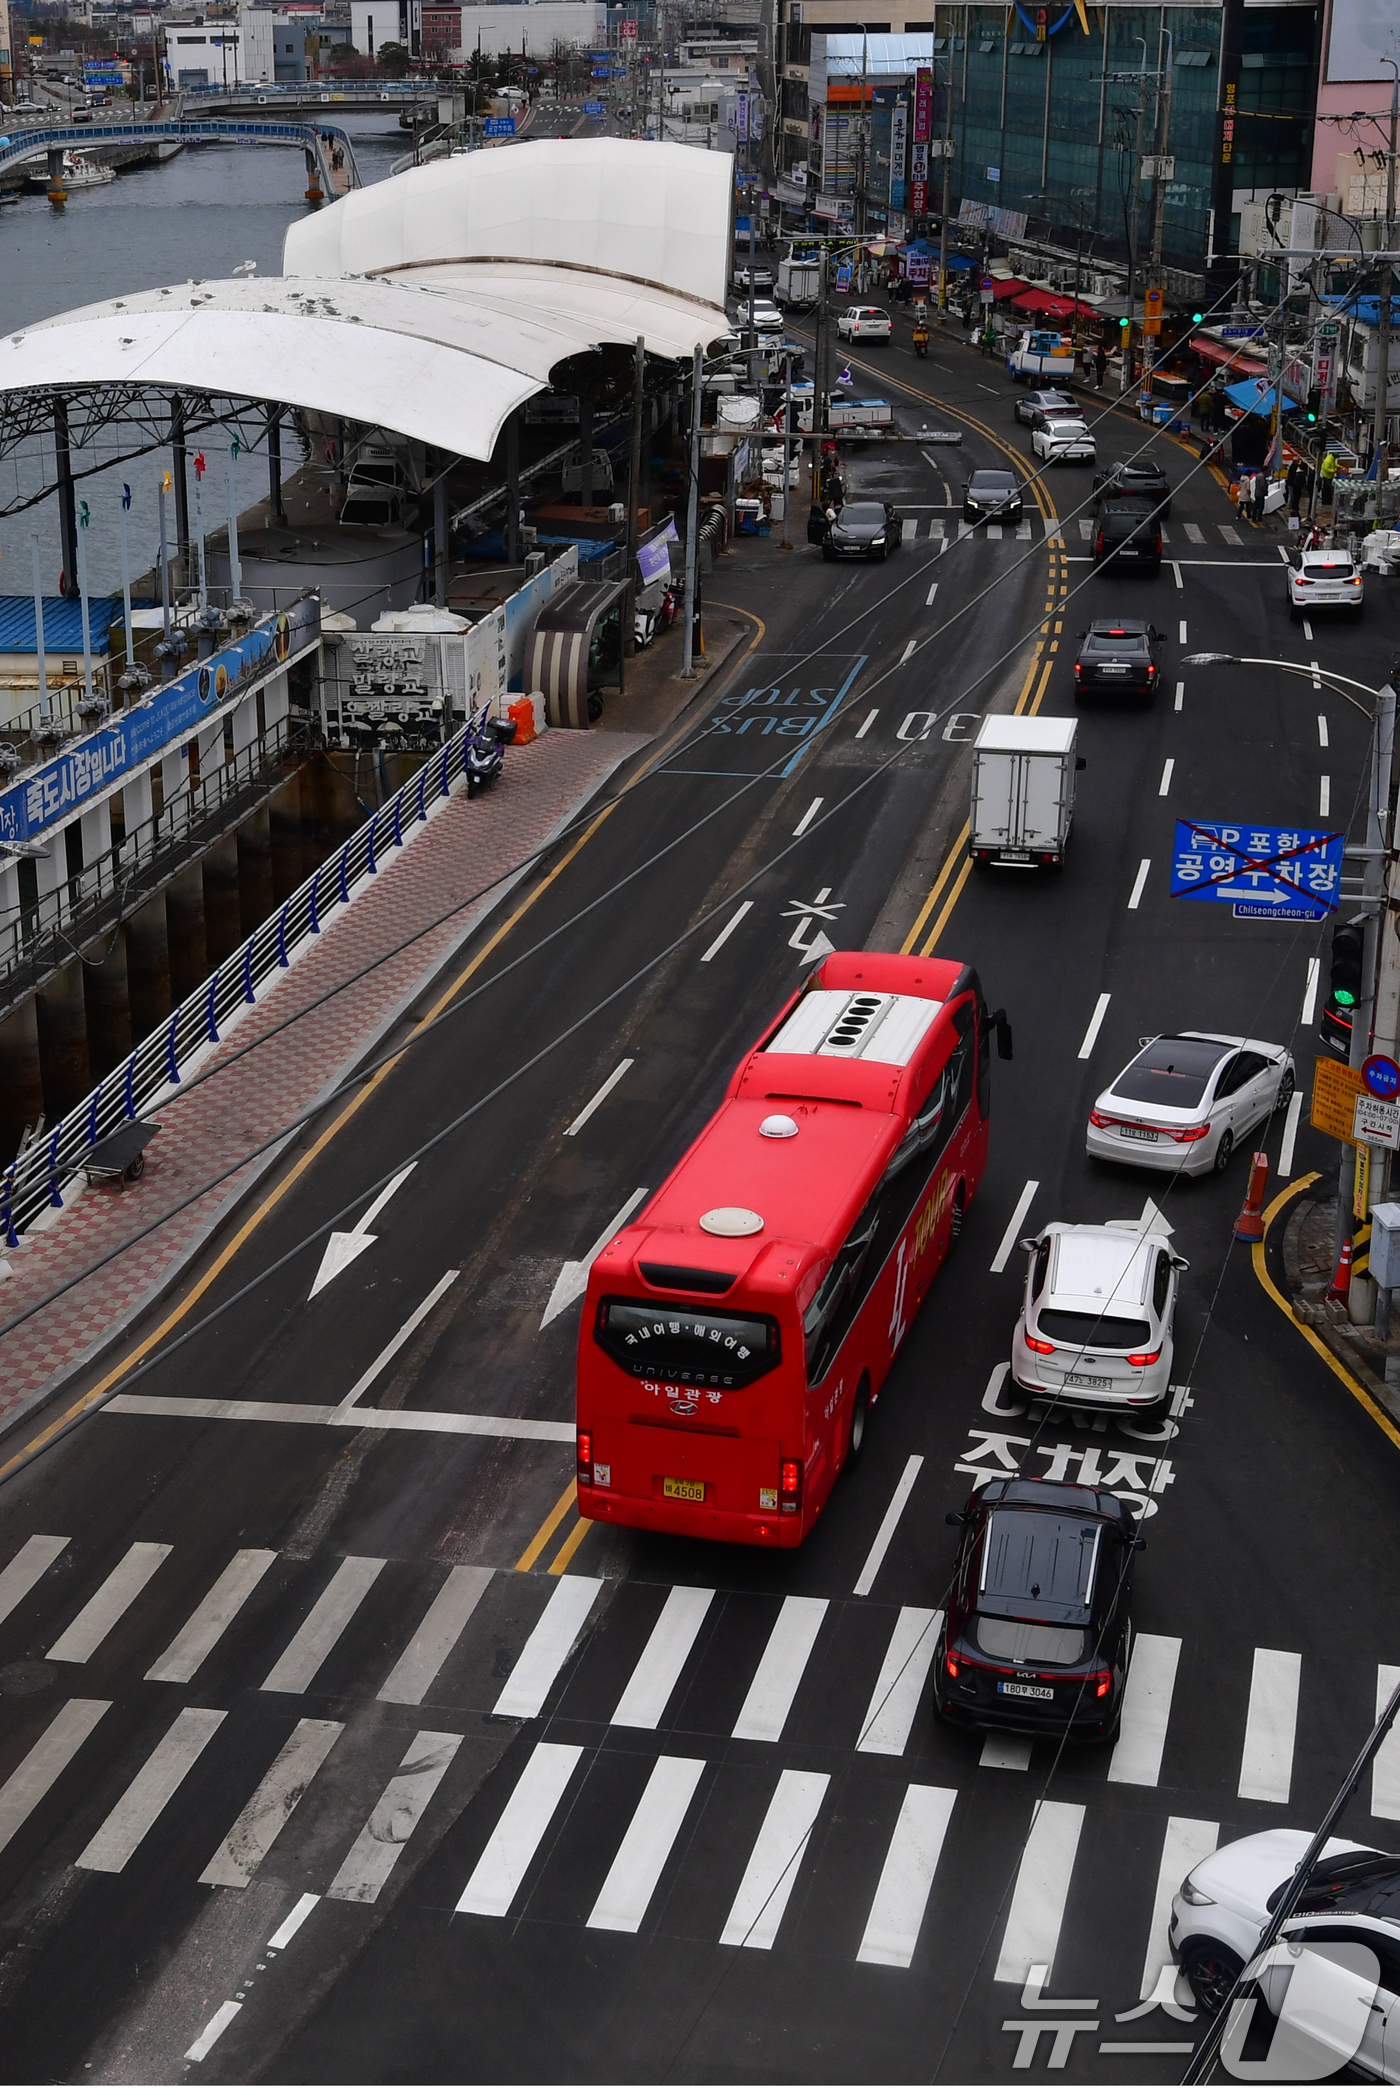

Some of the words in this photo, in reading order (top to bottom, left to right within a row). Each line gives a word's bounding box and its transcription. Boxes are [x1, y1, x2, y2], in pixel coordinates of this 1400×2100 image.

[913, 182, 924, 208] 주차장
[909, 267, 930, 279] 주차
[351, 642, 424, 666] 살랑고
[352, 671, 425, 695] 말랑고
[721, 687, 836, 706] STOP
[342, 700, 438, 723] 우짤랑고
[702, 716, 818, 736] BUS
[895, 711, 982, 742] 30
[26, 733, 127, 825] 죽도시장입니다
[1221, 829, 1240, 851] P
[1247, 832, 1328, 859] 포항시
[1175, 853, 1338, 892] 공영주차장
[1238, 905, 1316, 918] Chilseongcheon-gil
[1369, 1069, 1398, 1085] 주차금지
[1359, 1100, 1399, 1119] 주차허용시간
[913, 1166, 949, 1271] TOUR
[633, 1364, 734, 1384] UNIVERSE
[1087, 1377, 1107, 1387] 3825
[644, 1381, 723, 1404] 아일관광
[954, 1429, 1176, 1520] 주차장
[665, 1484, 673, 1493] 바
[673, 1484, 702, 1500] 4508
[1005, 1684, 1028, 1694] 180무
[1030, 1687, 1052, 1698] 3046
